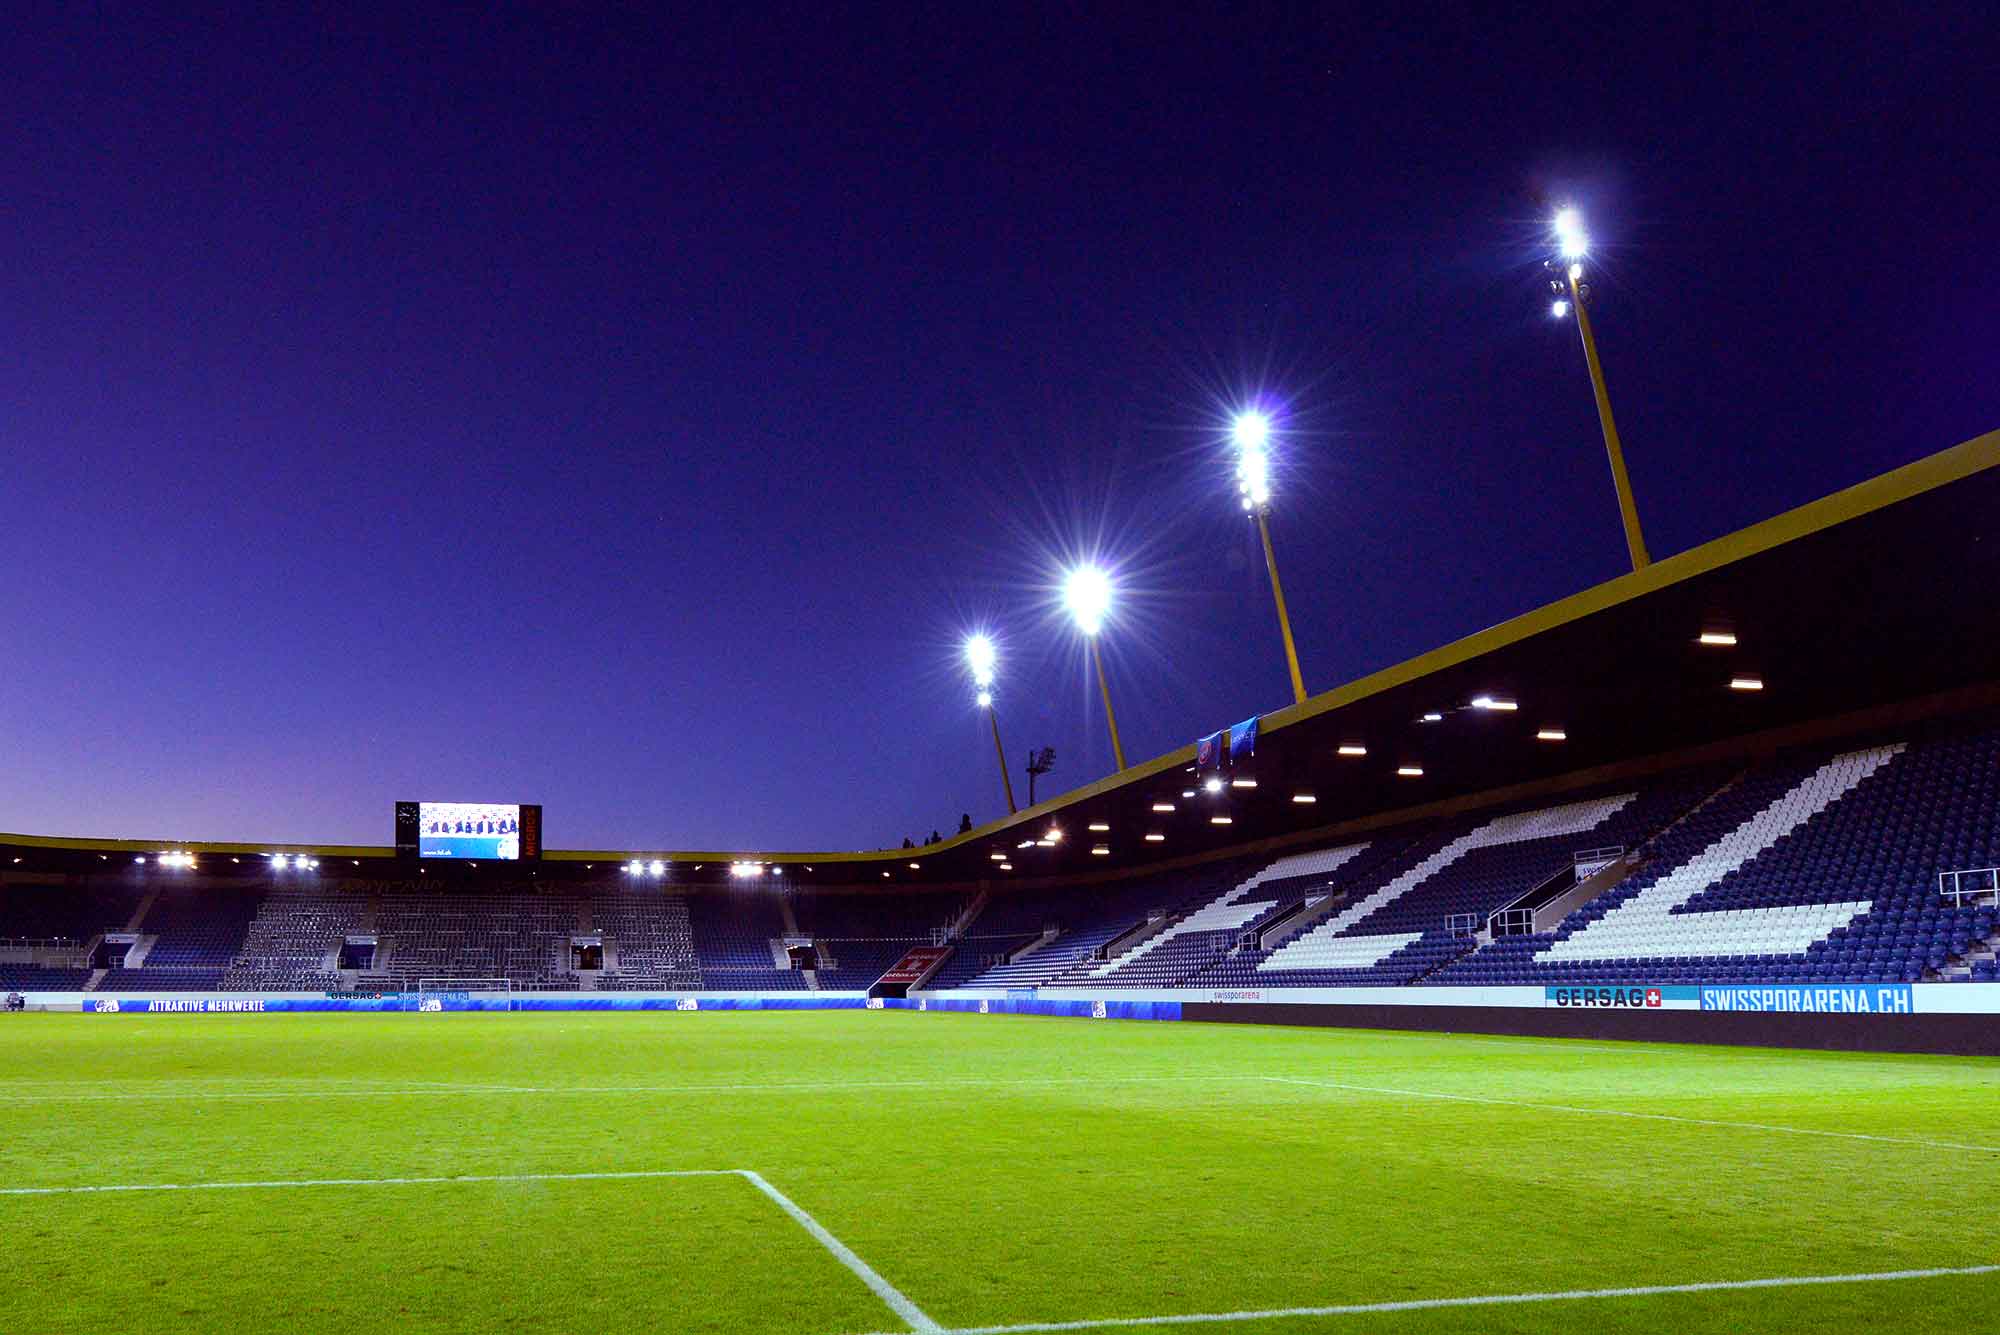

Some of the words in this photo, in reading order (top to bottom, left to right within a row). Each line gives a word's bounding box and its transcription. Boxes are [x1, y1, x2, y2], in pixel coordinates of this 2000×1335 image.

[1215, 992, 1260, 1000] swissporarena
[1556, 988, 1644, 1007] GERSAG
[1703, 989, 1909, 1013] SWISSPORARENA.CH
[149, 1000, 204, 1012] ATTRAKTIVE
[207, 1000, 265, 1012] MEHRWERTE
